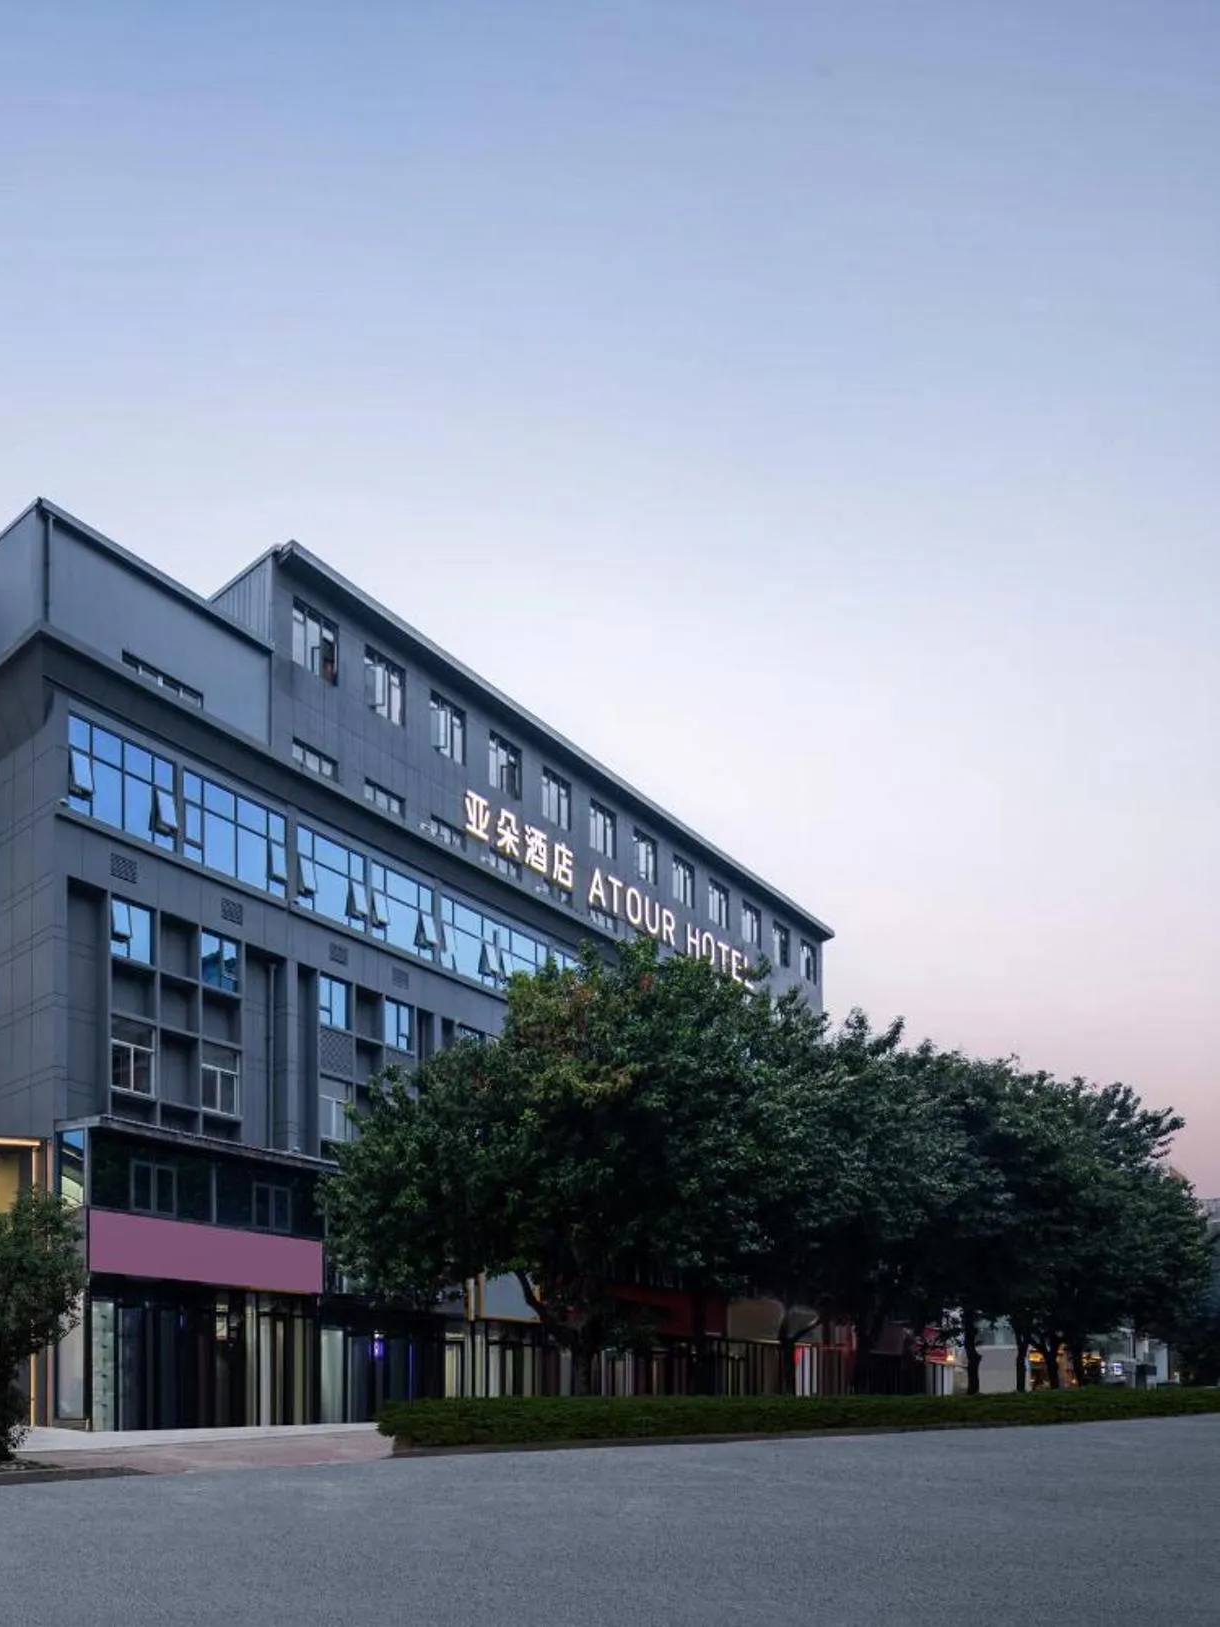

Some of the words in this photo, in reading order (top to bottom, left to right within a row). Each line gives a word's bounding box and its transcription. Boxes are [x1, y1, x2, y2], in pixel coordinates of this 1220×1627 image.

[464, 789, 575, 889] 亚朵酒店
[588, 868, 676, 948] ATOUR
[687, 922, 755, 990] HOTEL
